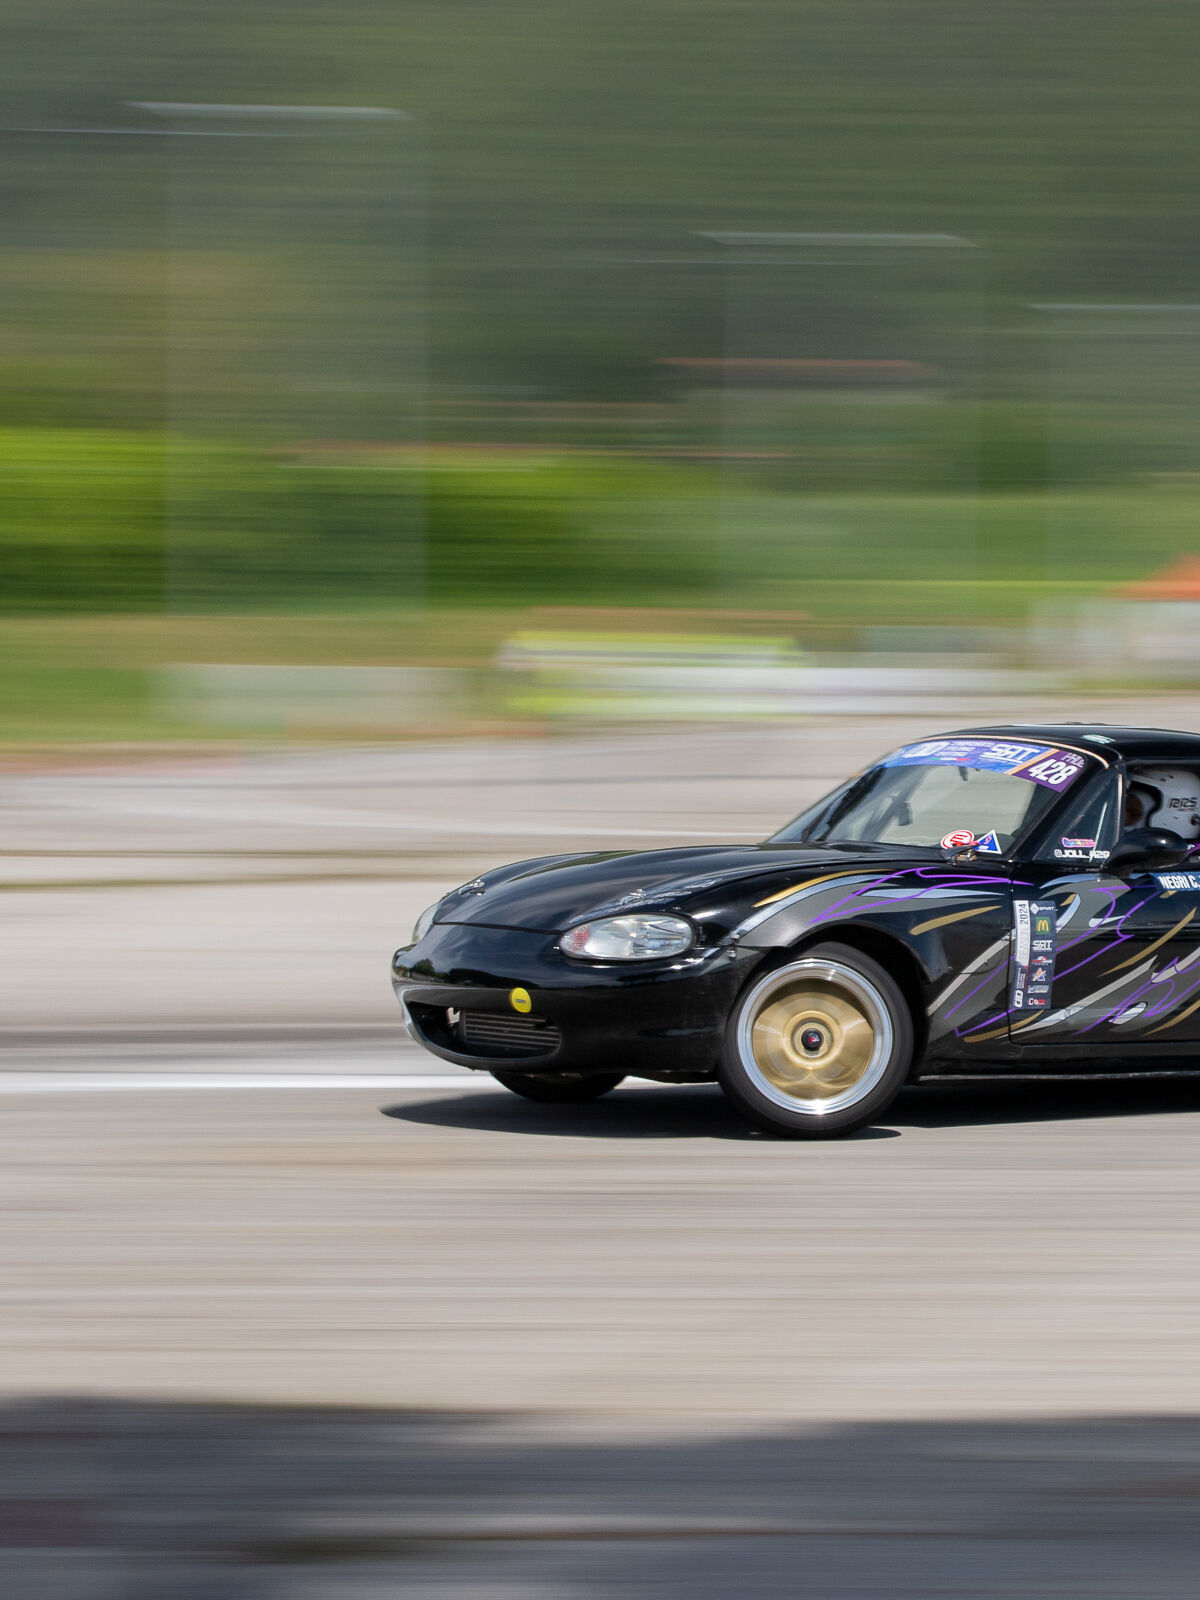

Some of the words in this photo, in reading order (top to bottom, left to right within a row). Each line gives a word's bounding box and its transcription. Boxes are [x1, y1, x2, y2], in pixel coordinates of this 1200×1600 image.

[1028, 758, 1078, 785] 428
[1158, 875, 1191, 889] NEGRI
[1019, 903, 1029, 925] 2024
